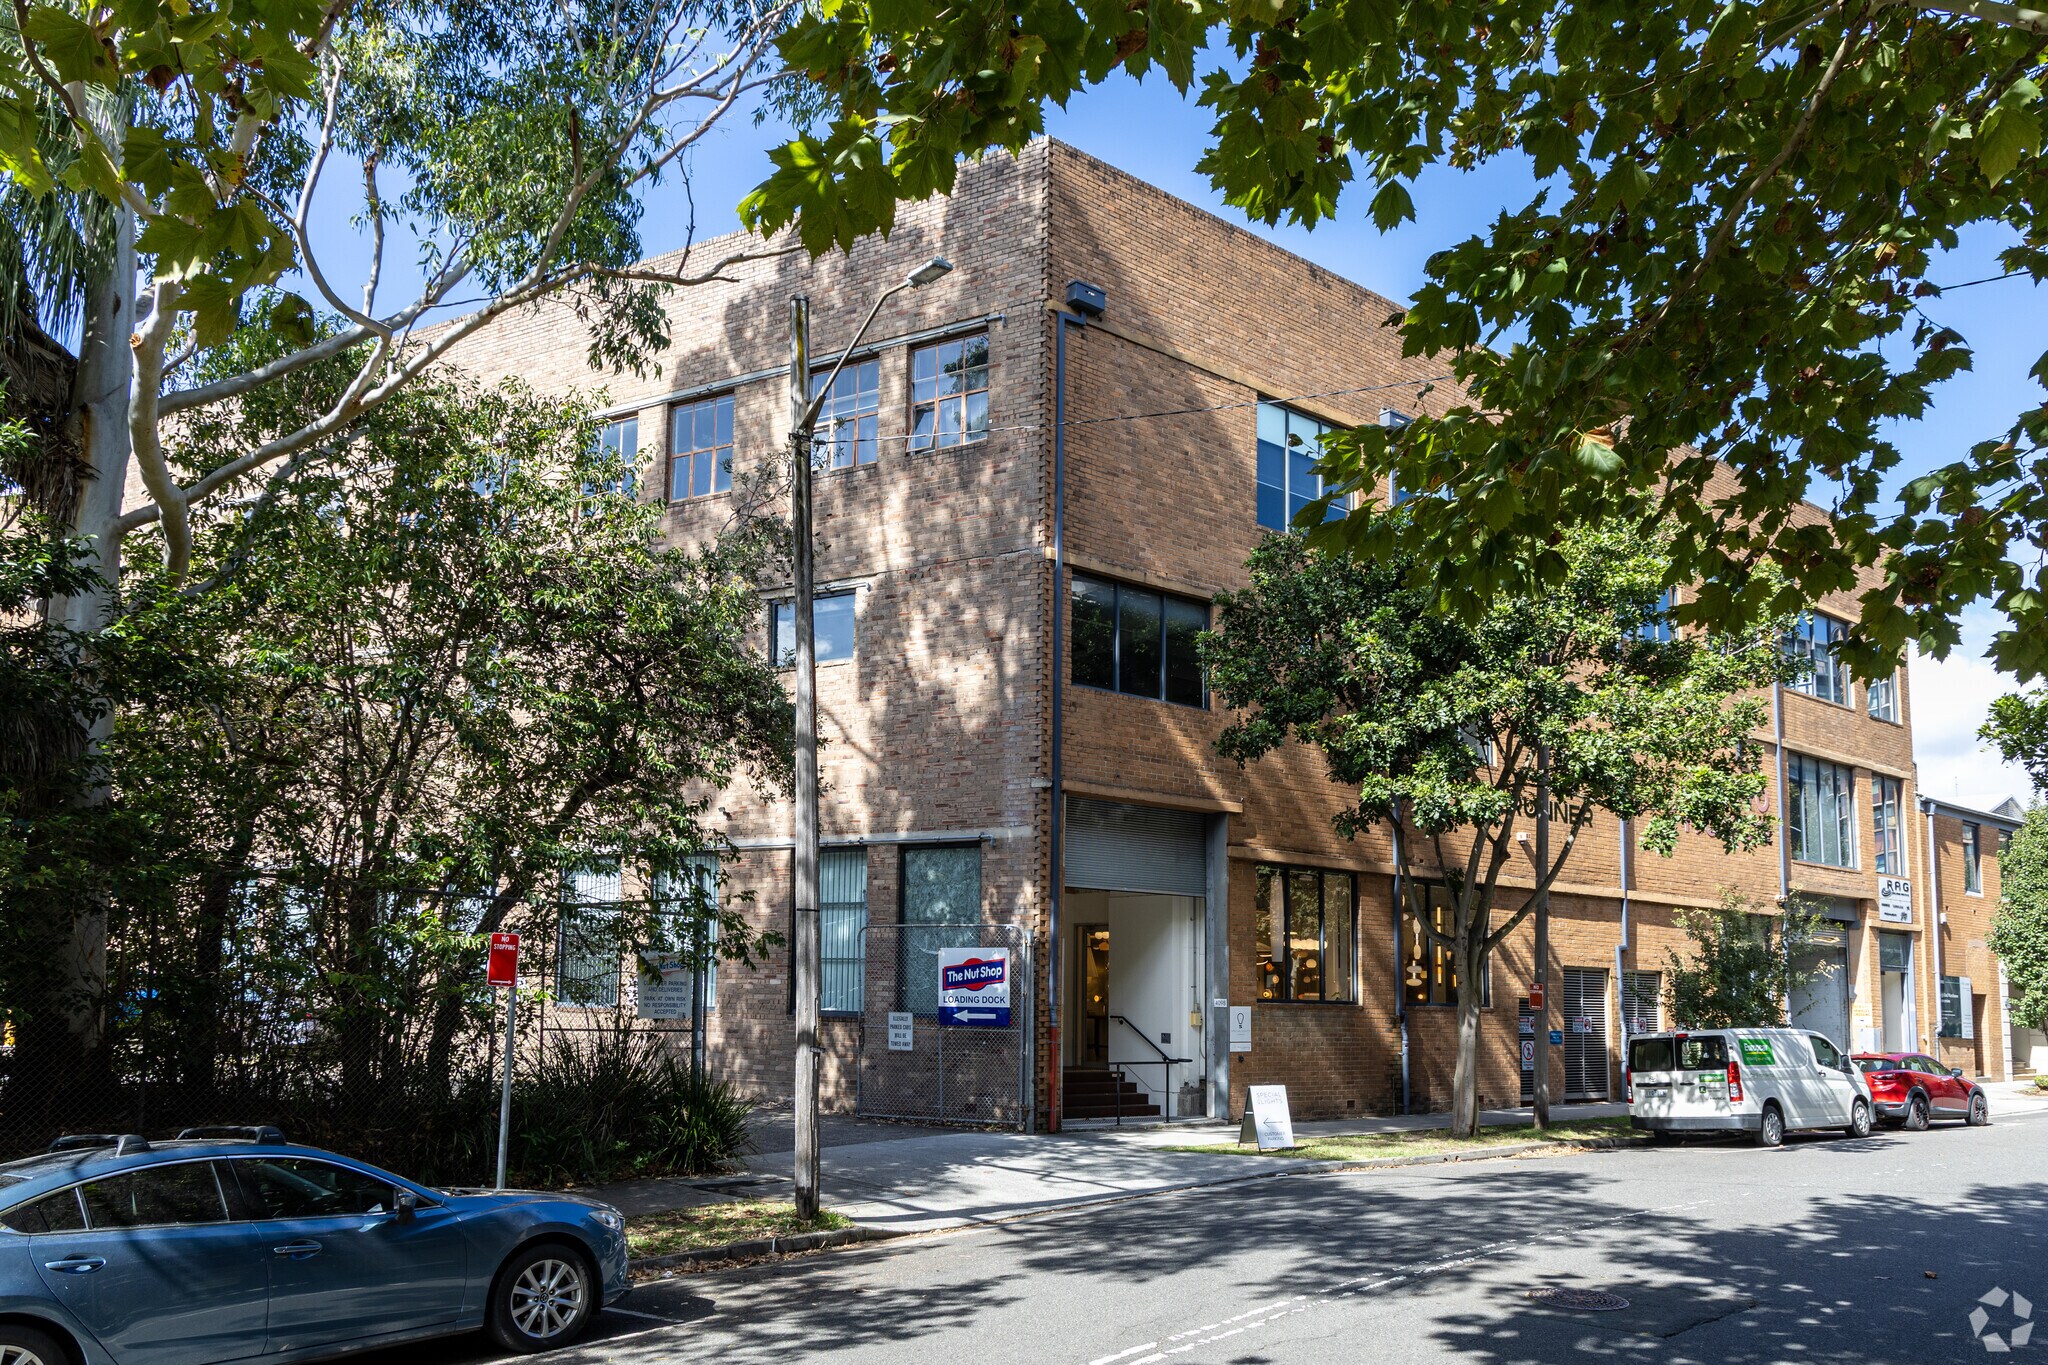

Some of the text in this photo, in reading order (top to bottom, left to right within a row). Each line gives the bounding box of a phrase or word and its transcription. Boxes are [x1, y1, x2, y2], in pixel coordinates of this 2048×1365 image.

[947, 966, 1002, 982] The Nut Shop
